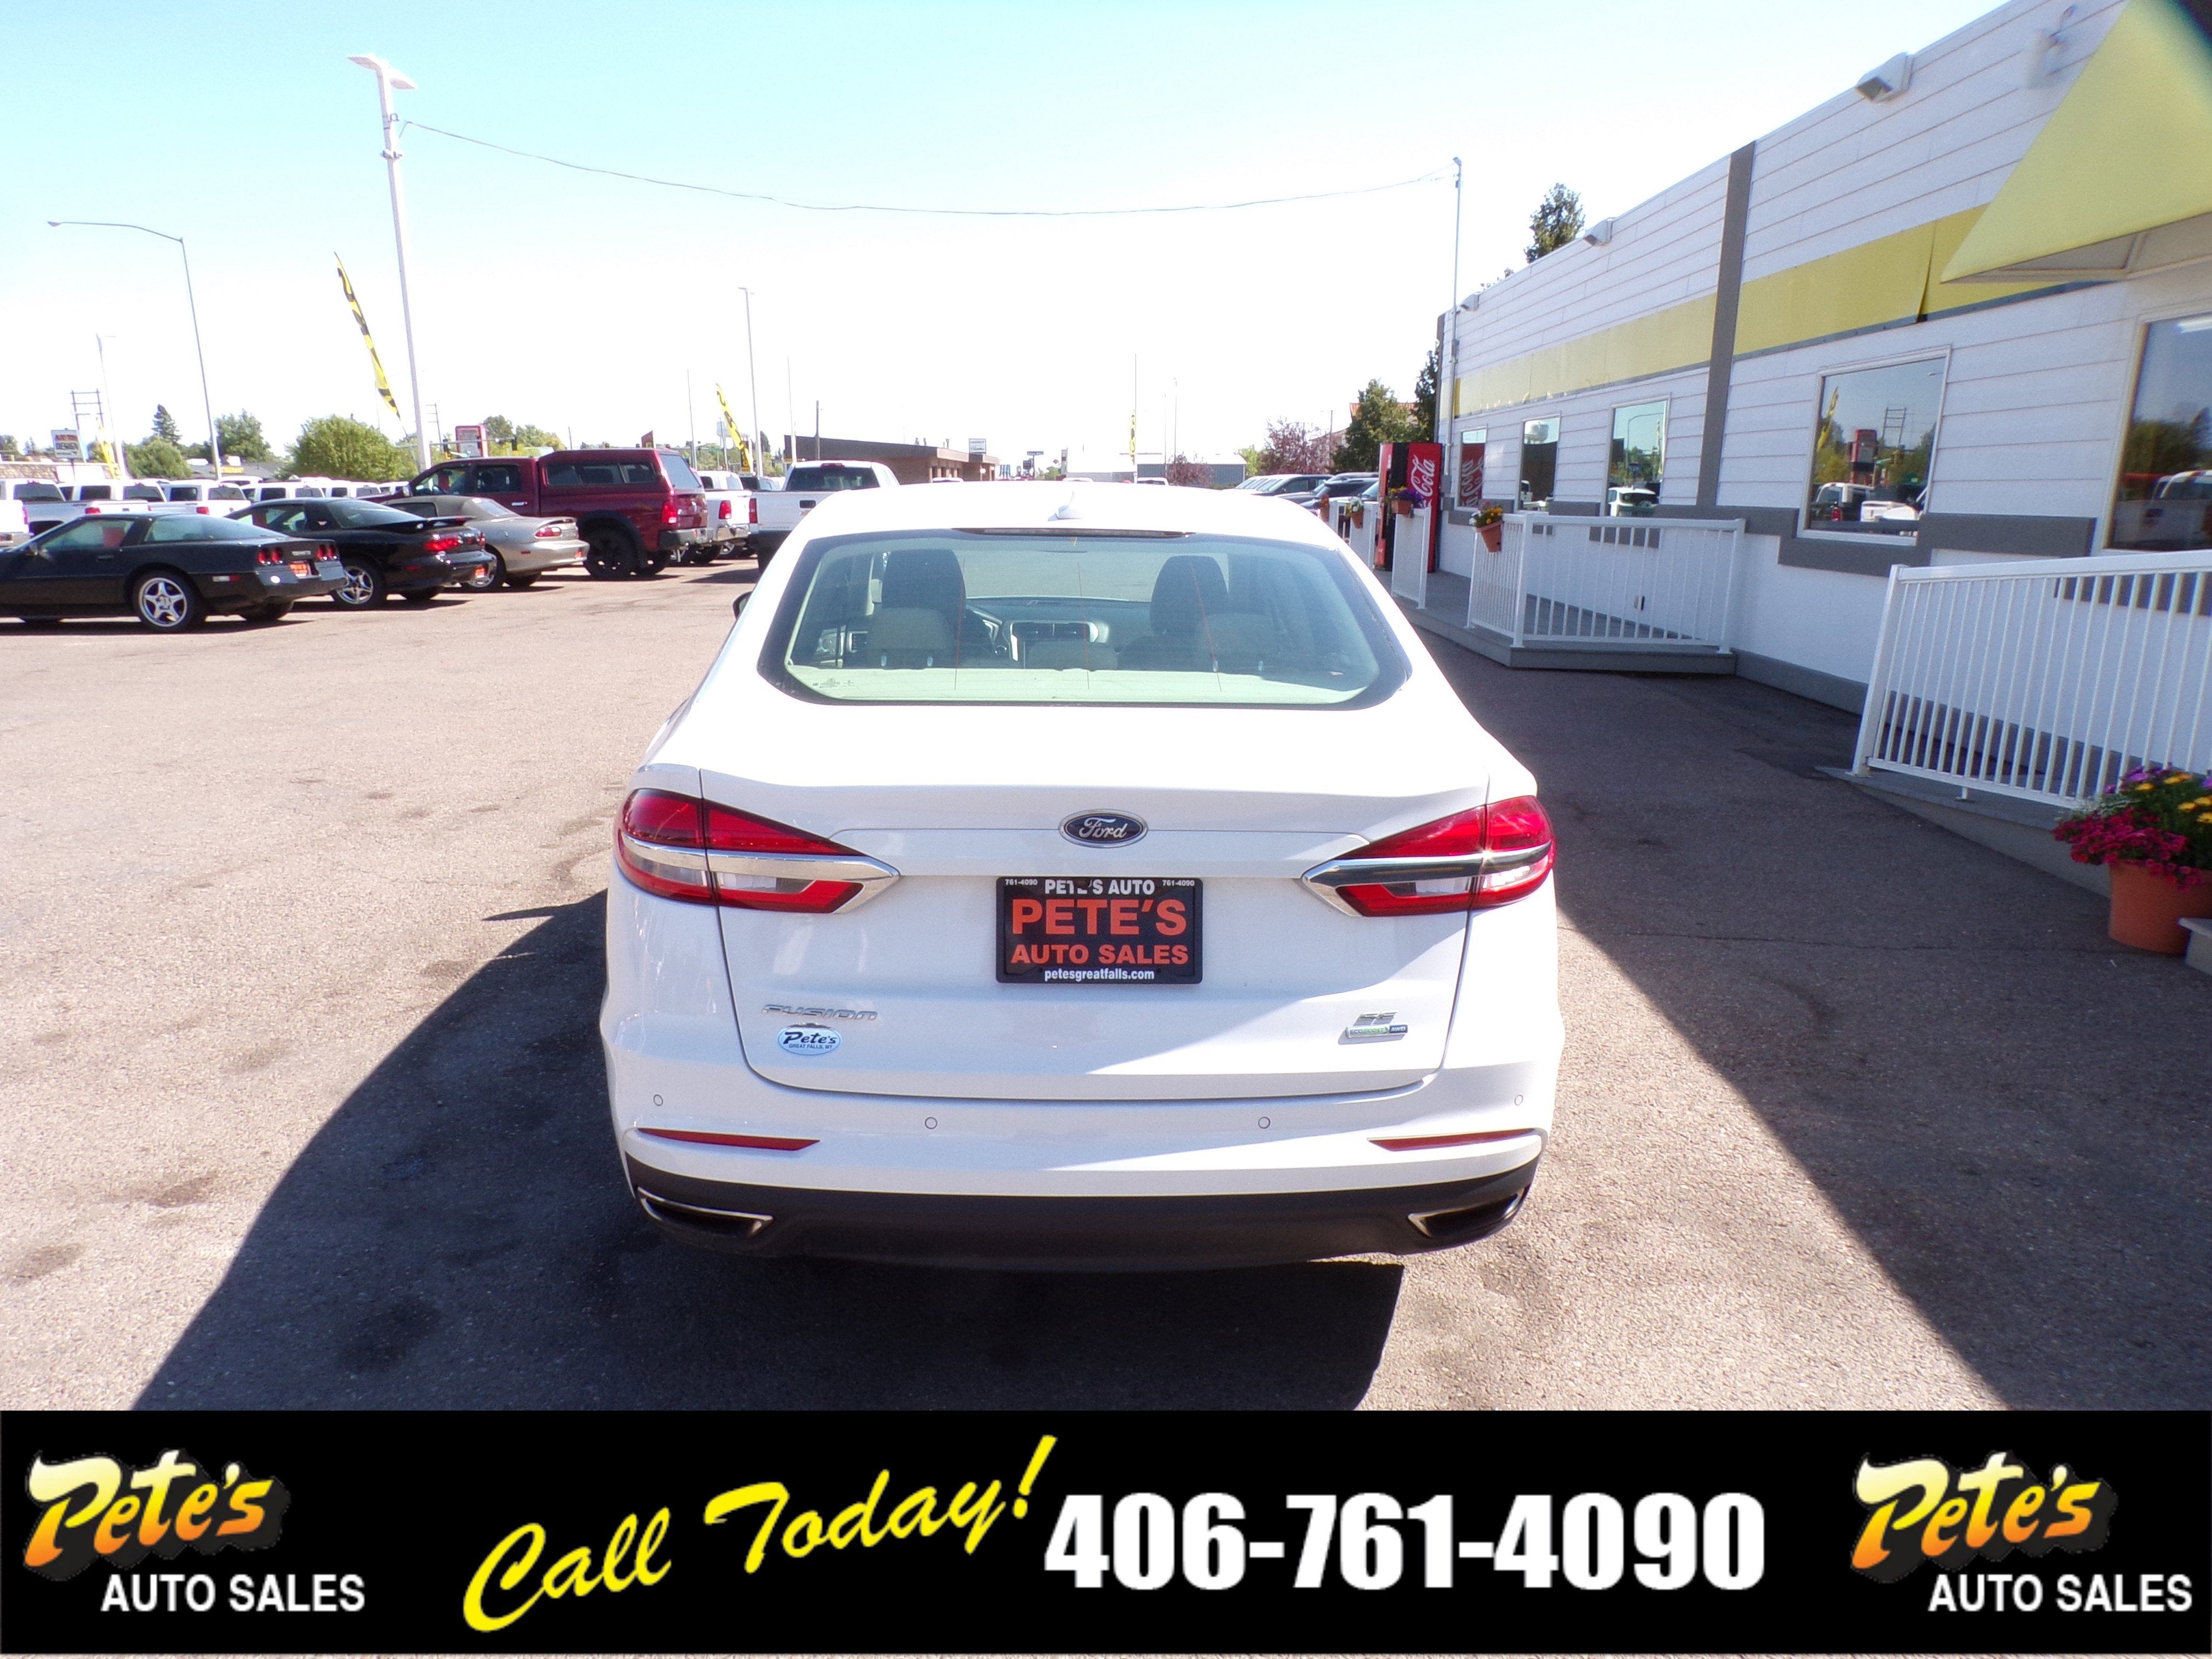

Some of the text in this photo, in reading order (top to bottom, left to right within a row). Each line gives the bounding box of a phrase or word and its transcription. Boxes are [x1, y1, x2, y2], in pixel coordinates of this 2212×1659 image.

[1411, 455, 1435, 497] Cola
[1079, 817, 1128, 838] Ford
[1108, 880, 1155, 895] AUTO
[1012, 899, 1186, 935] PETE'S
[1011, 945, 1188, 965] AUTO SALES
[1044, 968, 1155, 982] petesgreatfalls.com
[761, 1004, 878, 1020] FUSION
[783, 1031, 838, 1044] Pete's
